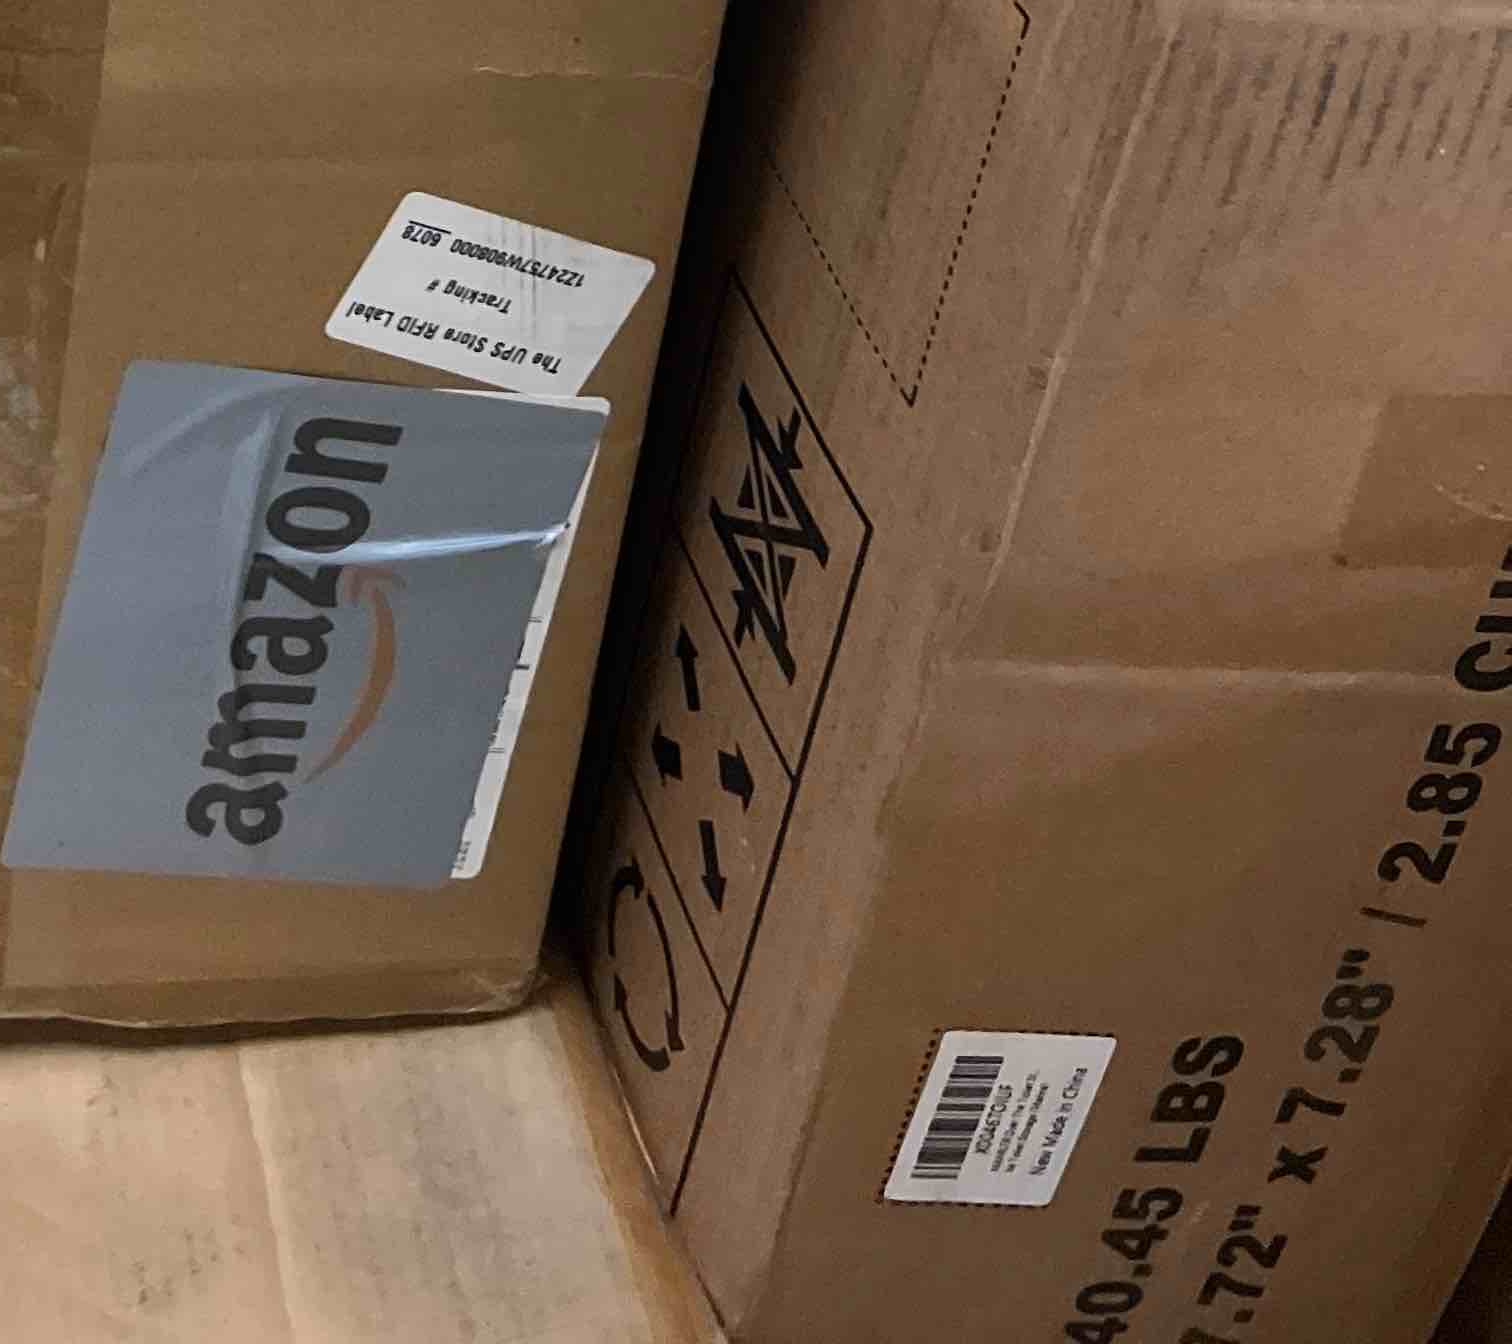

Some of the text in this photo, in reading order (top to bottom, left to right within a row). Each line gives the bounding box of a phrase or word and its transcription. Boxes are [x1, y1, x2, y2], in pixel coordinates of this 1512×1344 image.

[345, 301, 562, 375] The UPS Store RFID Label
[425, 279, 512, 314] Tracking #
[185, 414, 404, 846] amazon
[1275, 948, 1395, 1124] 7.28"
[1377, 722, 1503, 884] 2.85
[1042, 1117, 1069, 1146] Made
[1062, 1068, 1088, 1099] China
[1132, 1034, 1245, 1165] LBS
